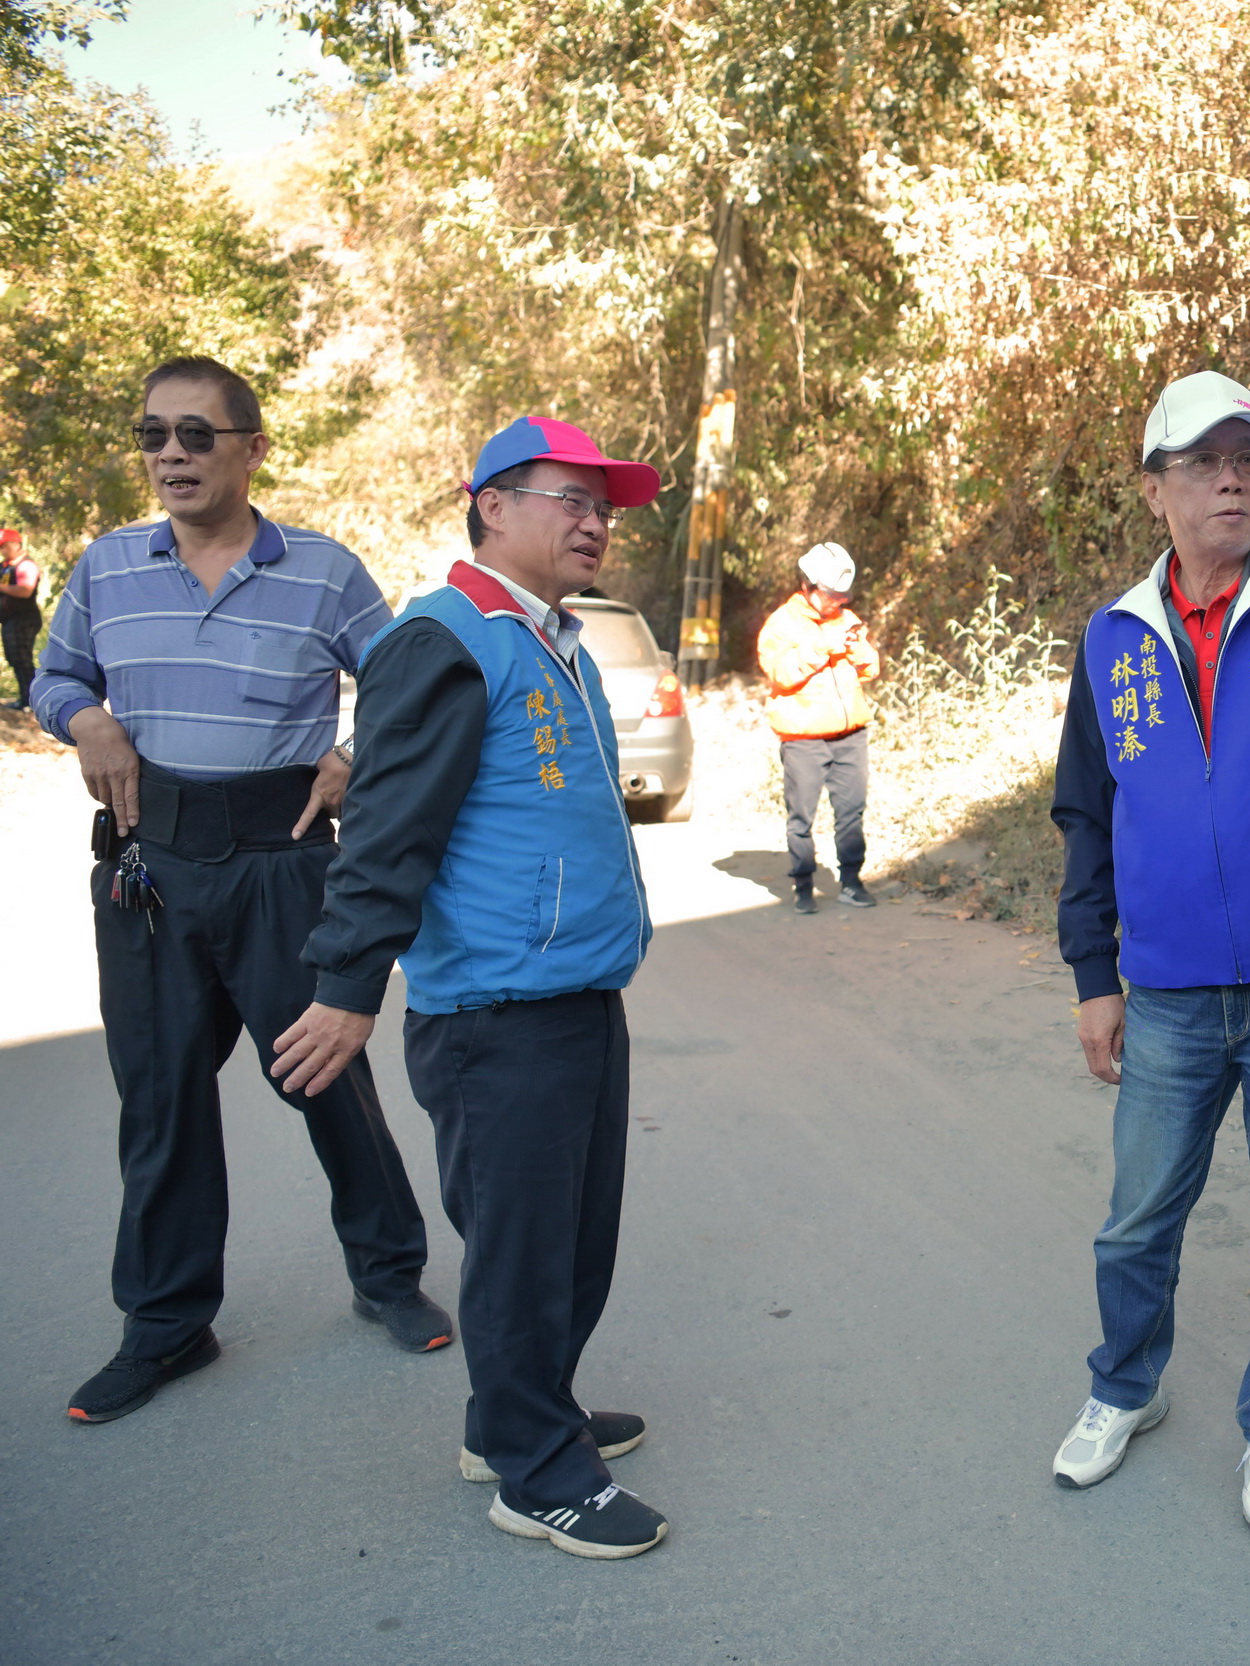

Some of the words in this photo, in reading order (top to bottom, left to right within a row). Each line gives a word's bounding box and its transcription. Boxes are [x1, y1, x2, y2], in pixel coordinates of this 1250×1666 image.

[1109, 652, 1147, 763] 林明溱
[1140, 633, 1166, 729] 南投縣長
[526, 688, 566, 792] 陳錫梧
